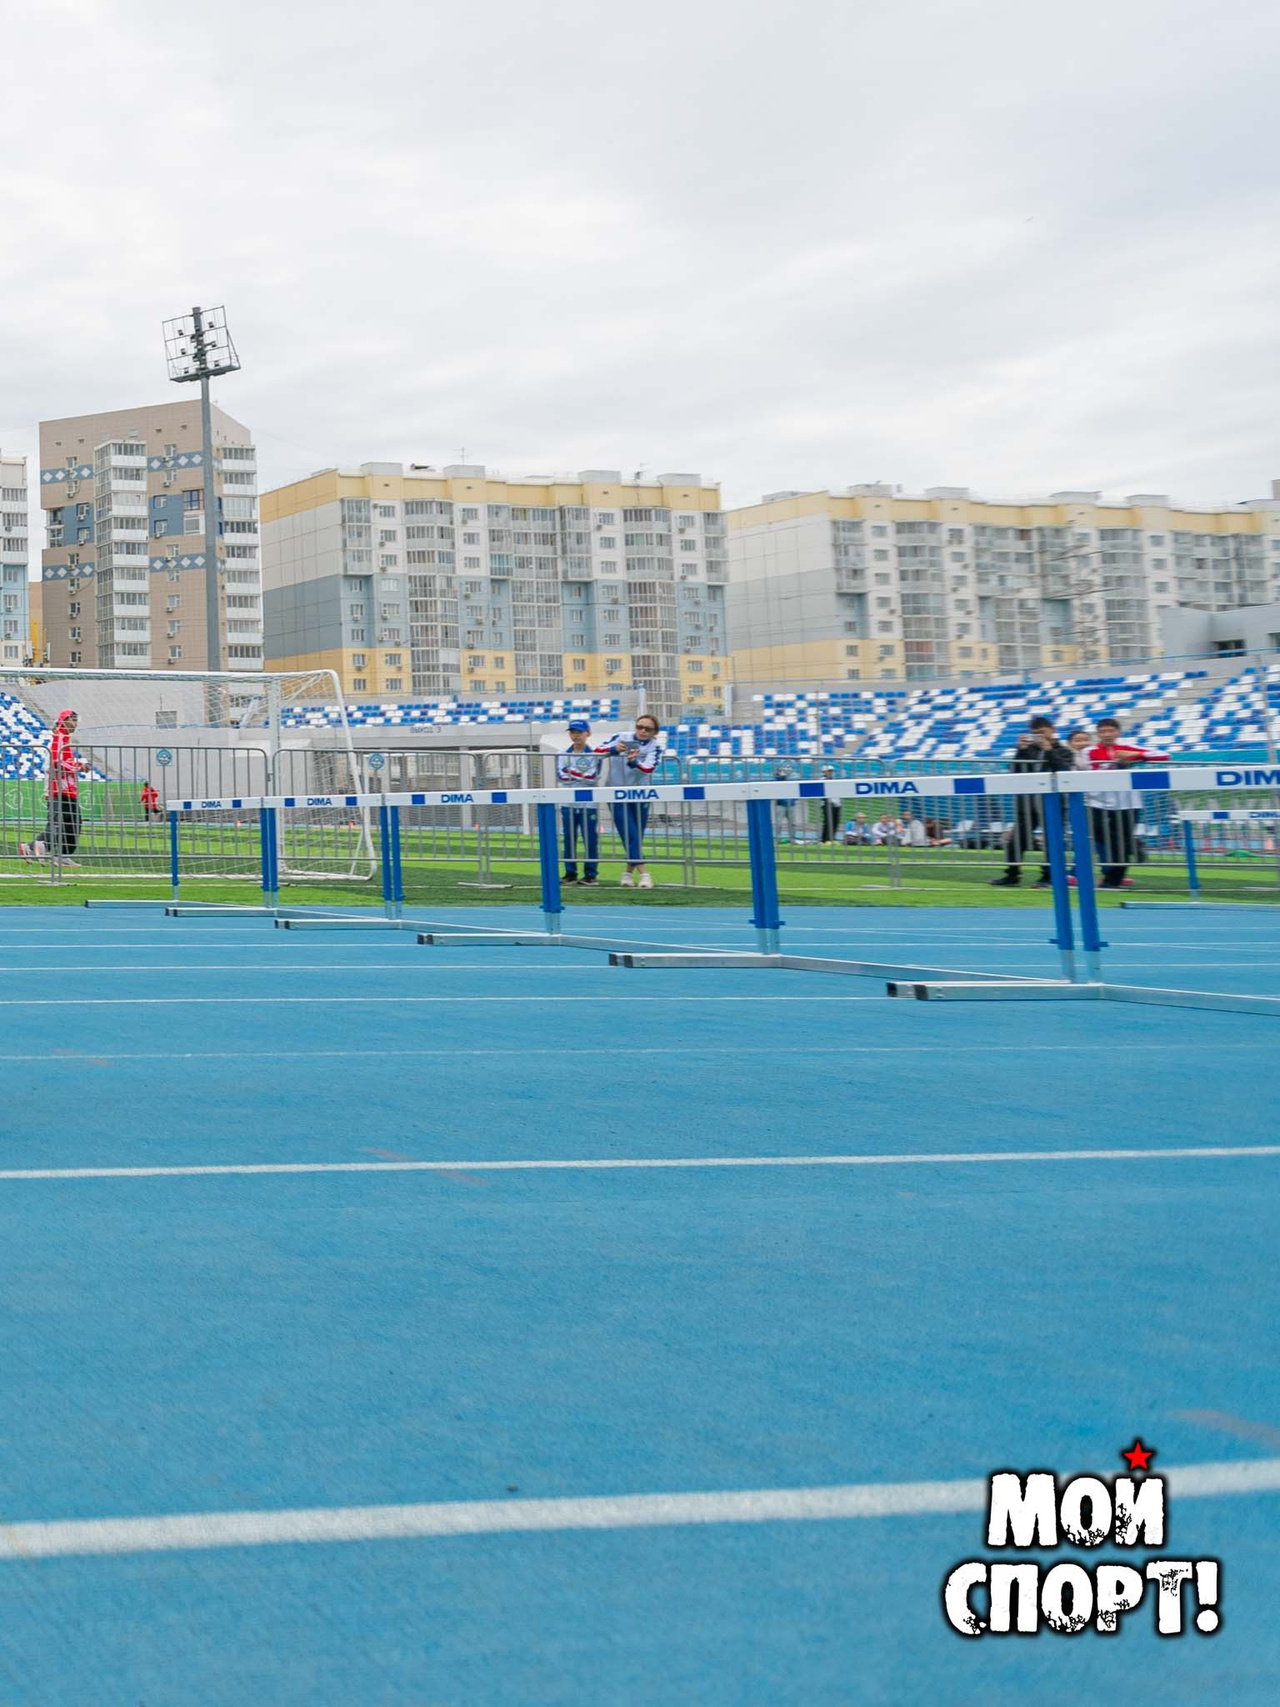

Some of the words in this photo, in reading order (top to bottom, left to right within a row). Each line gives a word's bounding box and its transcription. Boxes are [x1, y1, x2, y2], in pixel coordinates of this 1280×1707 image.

[1216, 770, 1280, 786] DIM
[855, 781, 920, 795] DIMA
[440, 793, 475, 803] DIMA
[614, 789, 660, 800] DIMA
[201, 800, 223, 809] DIMA
[306, 797, 333, 806] DIMA
